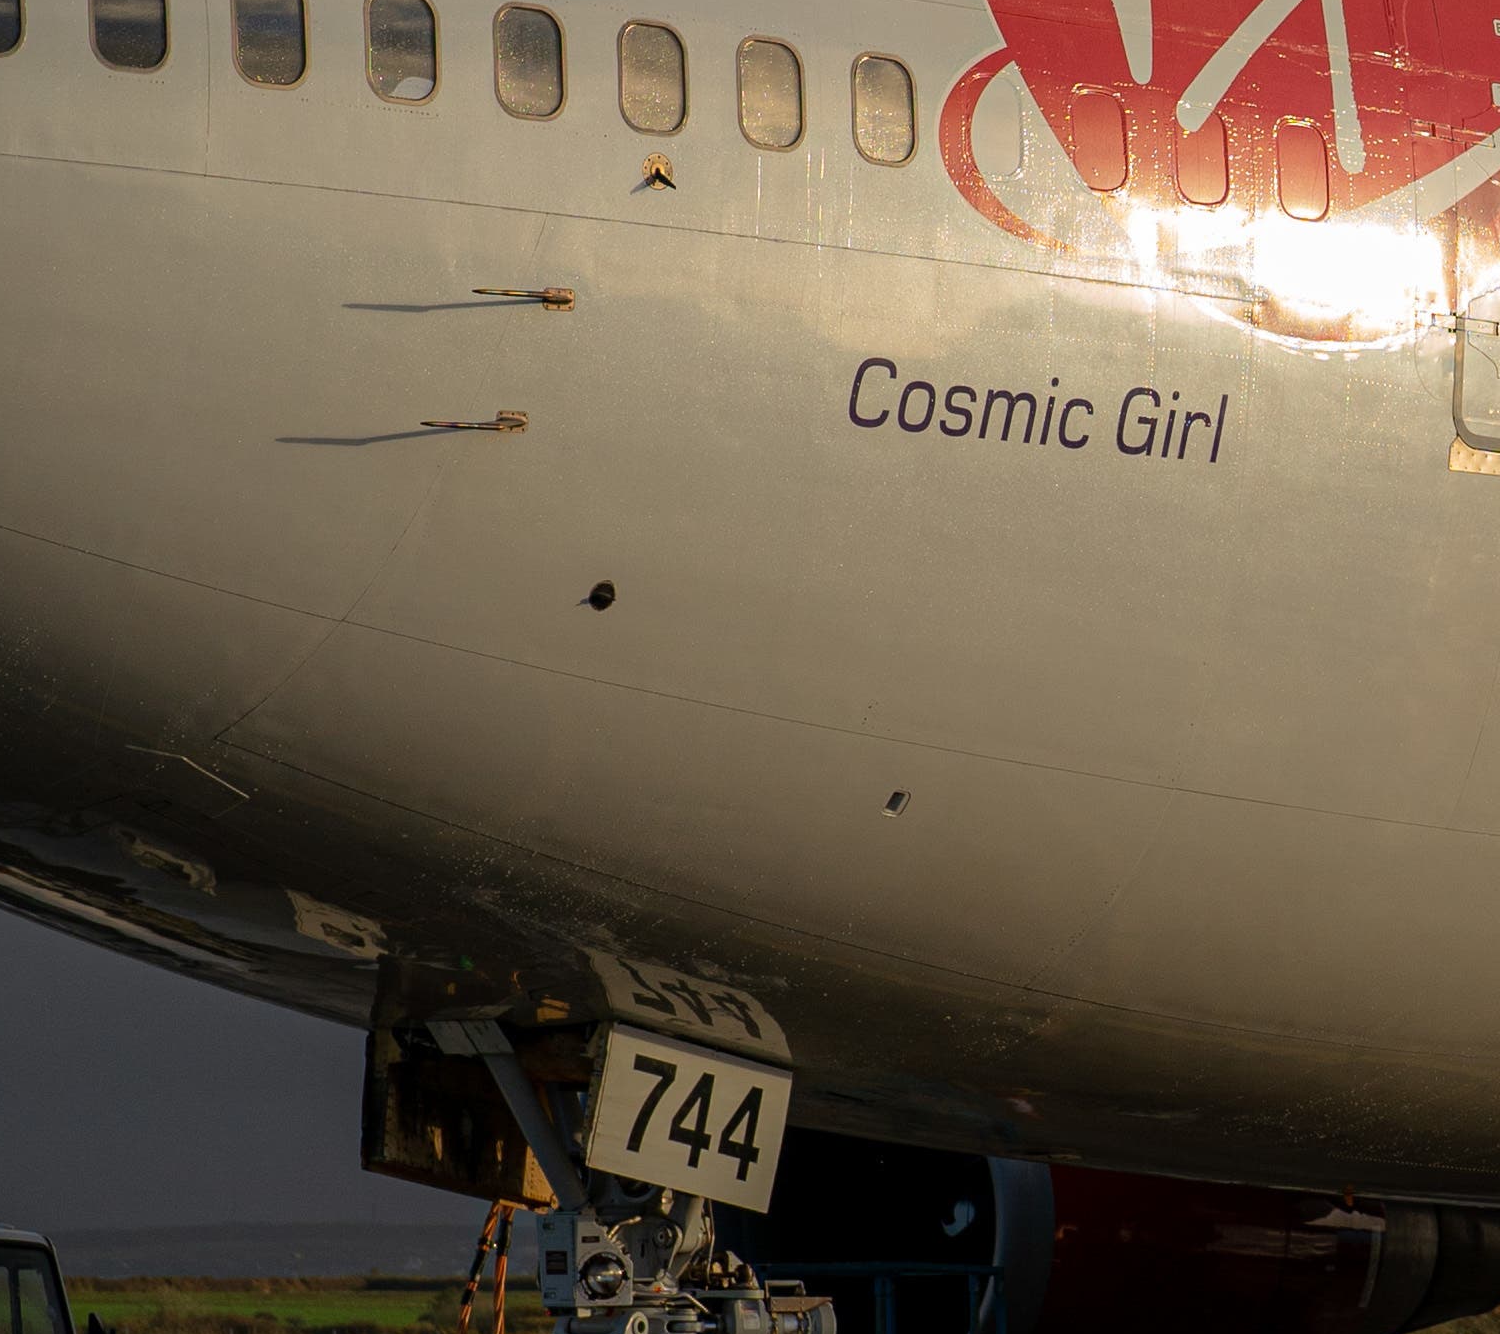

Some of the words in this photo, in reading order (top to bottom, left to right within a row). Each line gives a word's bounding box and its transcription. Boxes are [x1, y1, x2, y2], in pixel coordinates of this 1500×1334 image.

[848, 357, 1094, 450] Cosmic
[1116, 386, 1229, 463] Girl
[626, 1053, 763, 1182] 744
